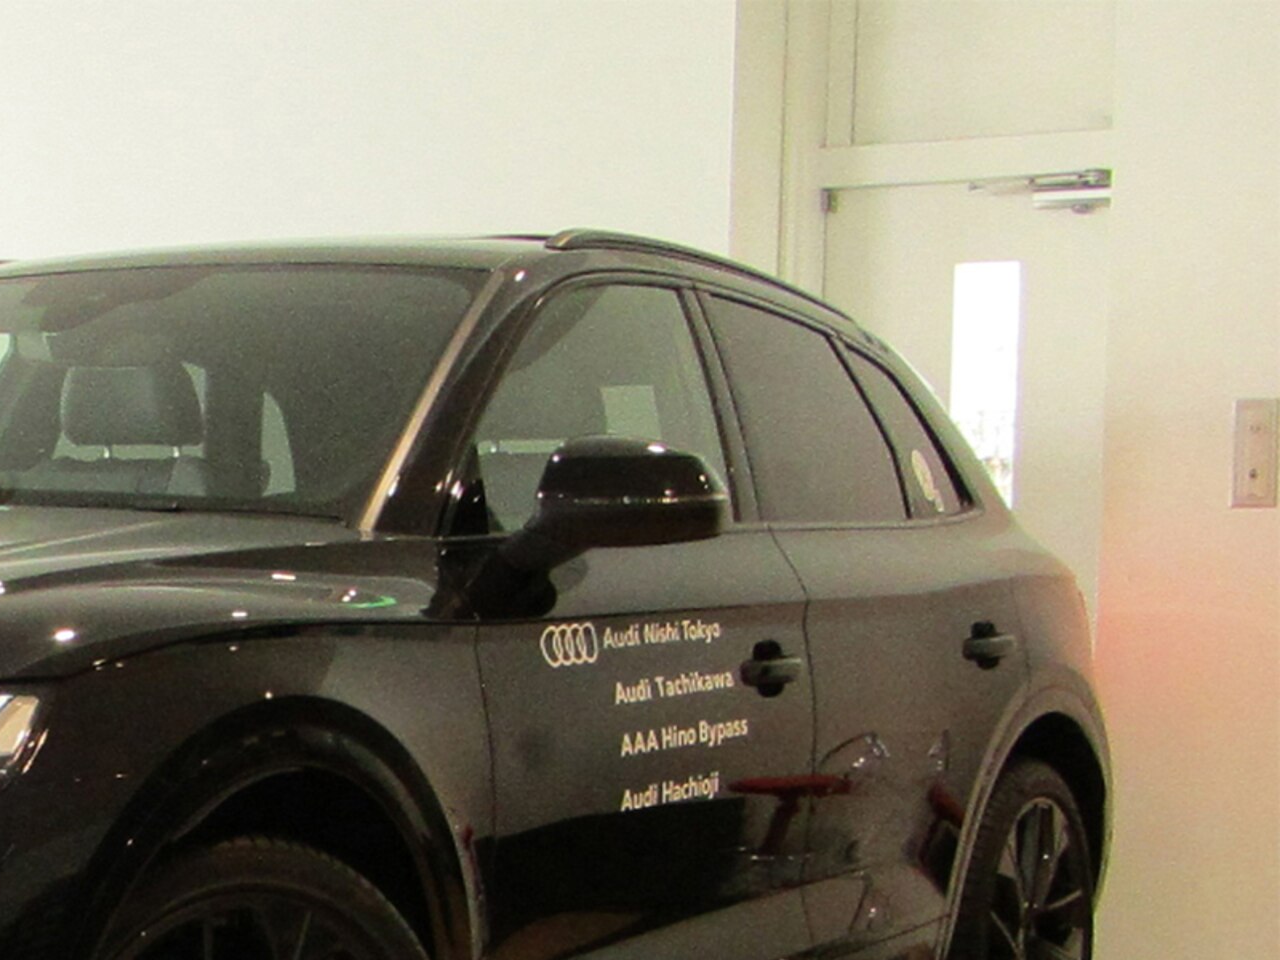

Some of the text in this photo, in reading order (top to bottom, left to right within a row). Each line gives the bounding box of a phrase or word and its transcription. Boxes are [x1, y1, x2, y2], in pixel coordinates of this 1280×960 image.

[603, 620, 721, 649] Audi Nishi Tokyo
[615, 671, 735, 705] Audi Tachikawa
[621, 718, 749, 757] AAA Hino Bypass
[621, 771, 720, 812] Audi Hachioji
